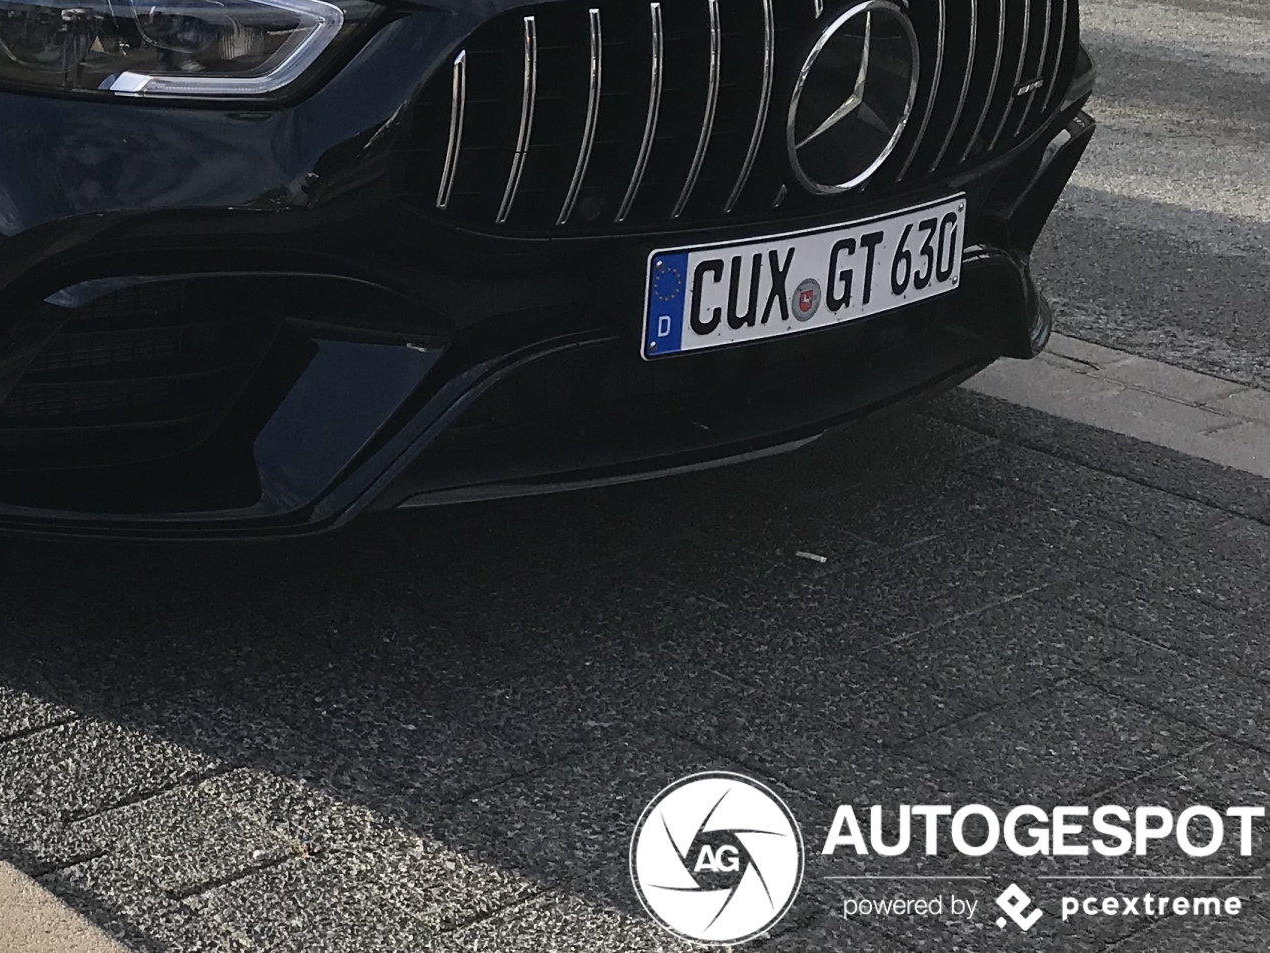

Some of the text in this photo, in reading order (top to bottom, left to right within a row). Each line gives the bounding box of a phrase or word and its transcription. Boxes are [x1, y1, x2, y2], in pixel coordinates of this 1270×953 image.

[689, 211, 958, 336] CUX GT 630
[657, 315, 671, 337] D
